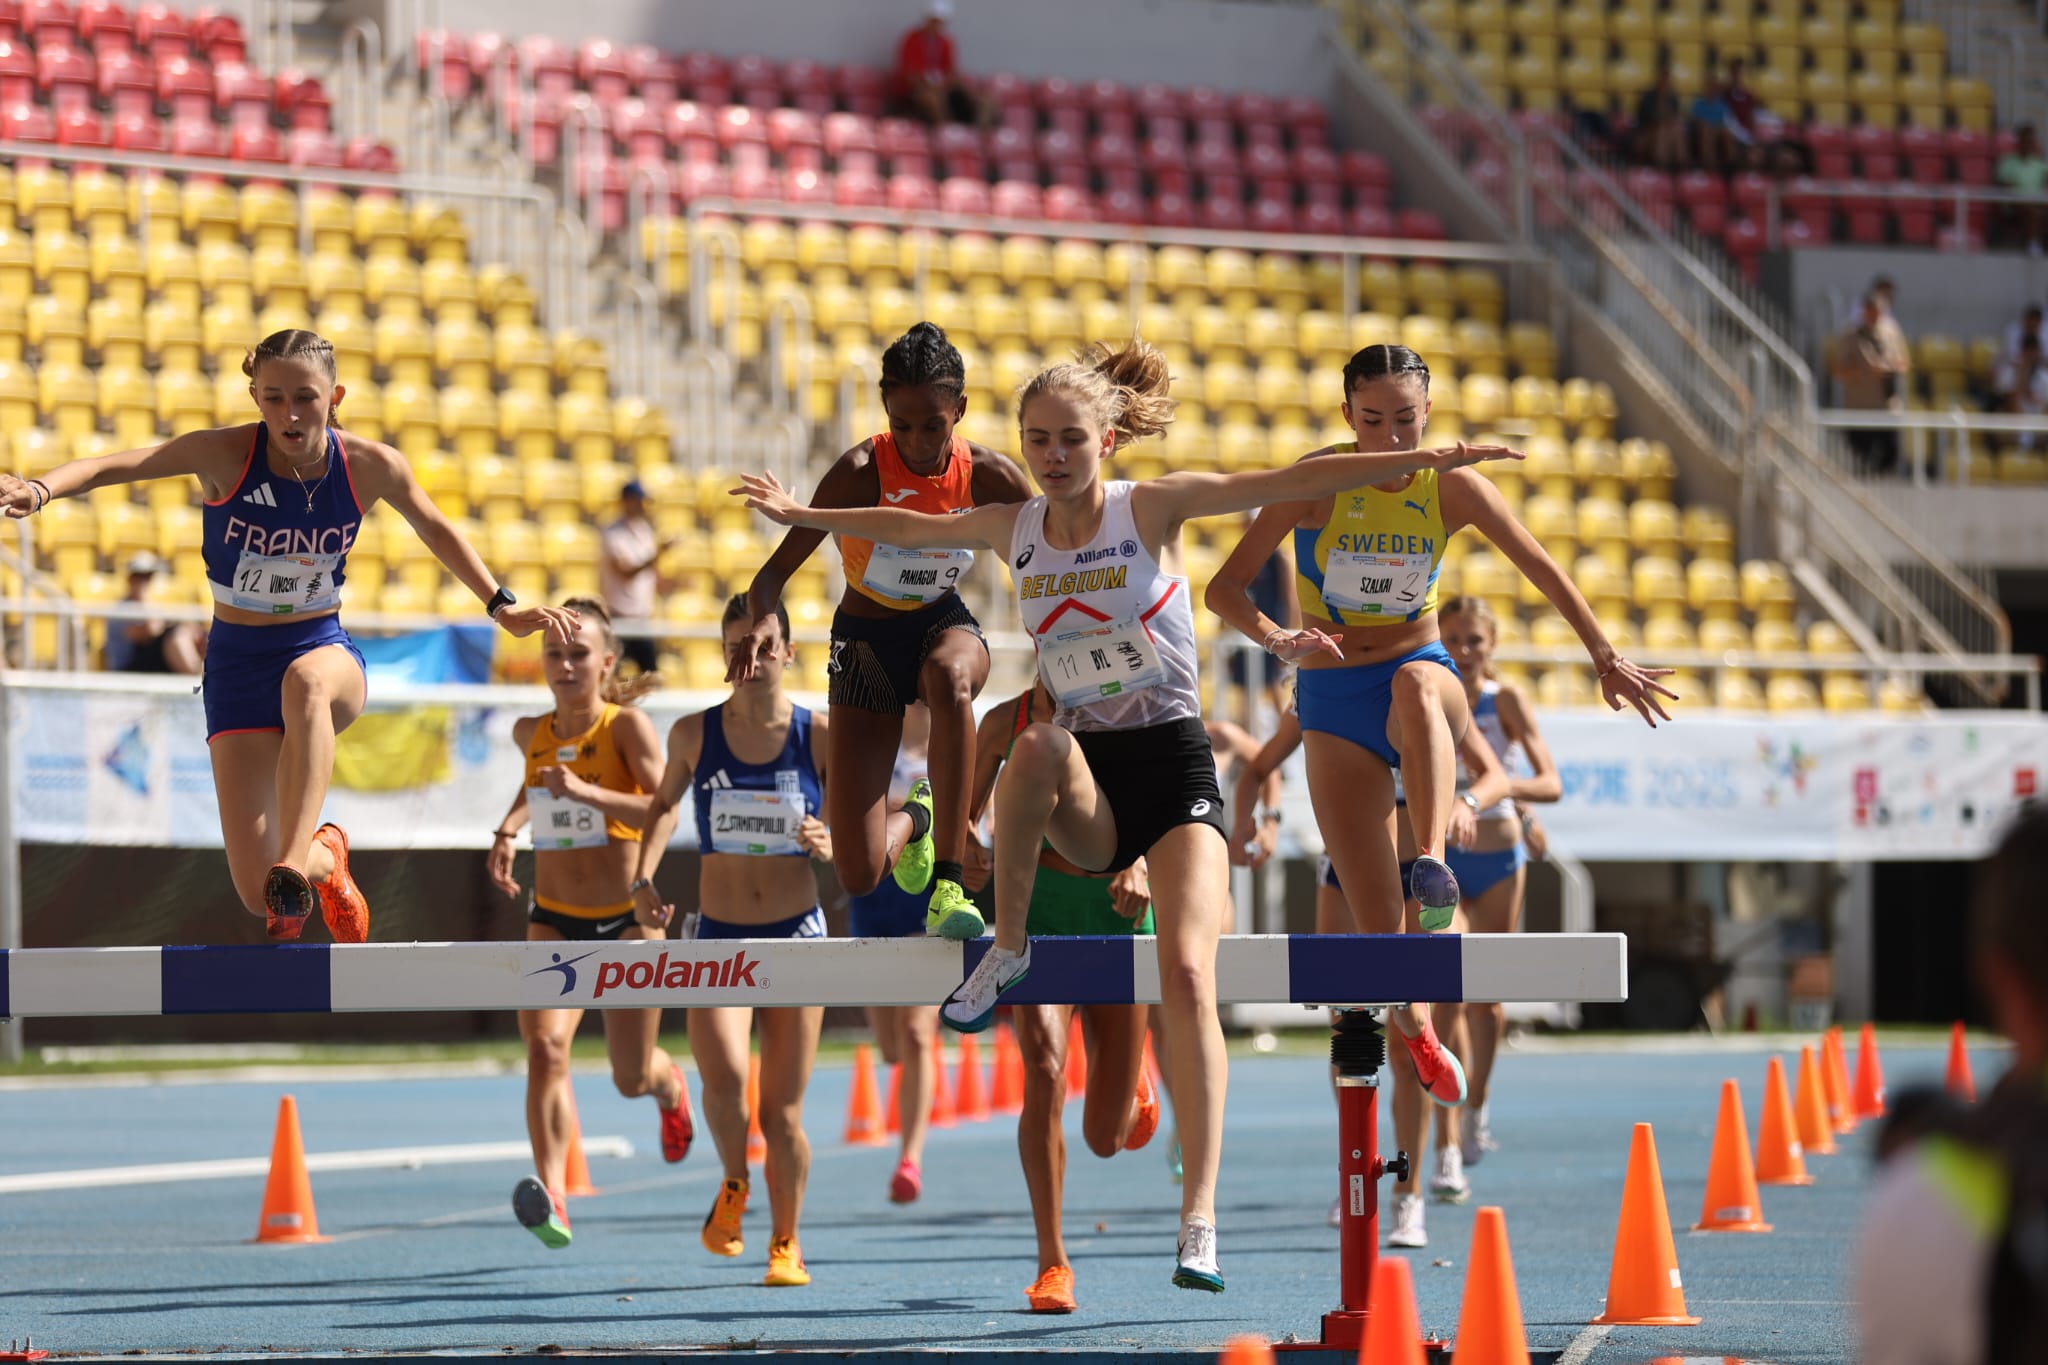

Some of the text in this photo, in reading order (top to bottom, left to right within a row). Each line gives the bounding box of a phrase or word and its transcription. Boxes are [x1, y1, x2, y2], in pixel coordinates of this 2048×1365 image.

[224, 515, 356, 558] FRANCE
[1337, 533, 1434, 555] SWEDEN
[1074, 546, 1118, 565] Allianz
[240, 568, 264, 593] 12
[269, 574, 301, 594] VINCENT
[898, 566, 960, 586] PANIAGUA 9
[1020, 565, 1127, 601] BELGIUM
[1360, 576, 1393, 595] SZALKAI
[593, 950, 761, 999] polanik
